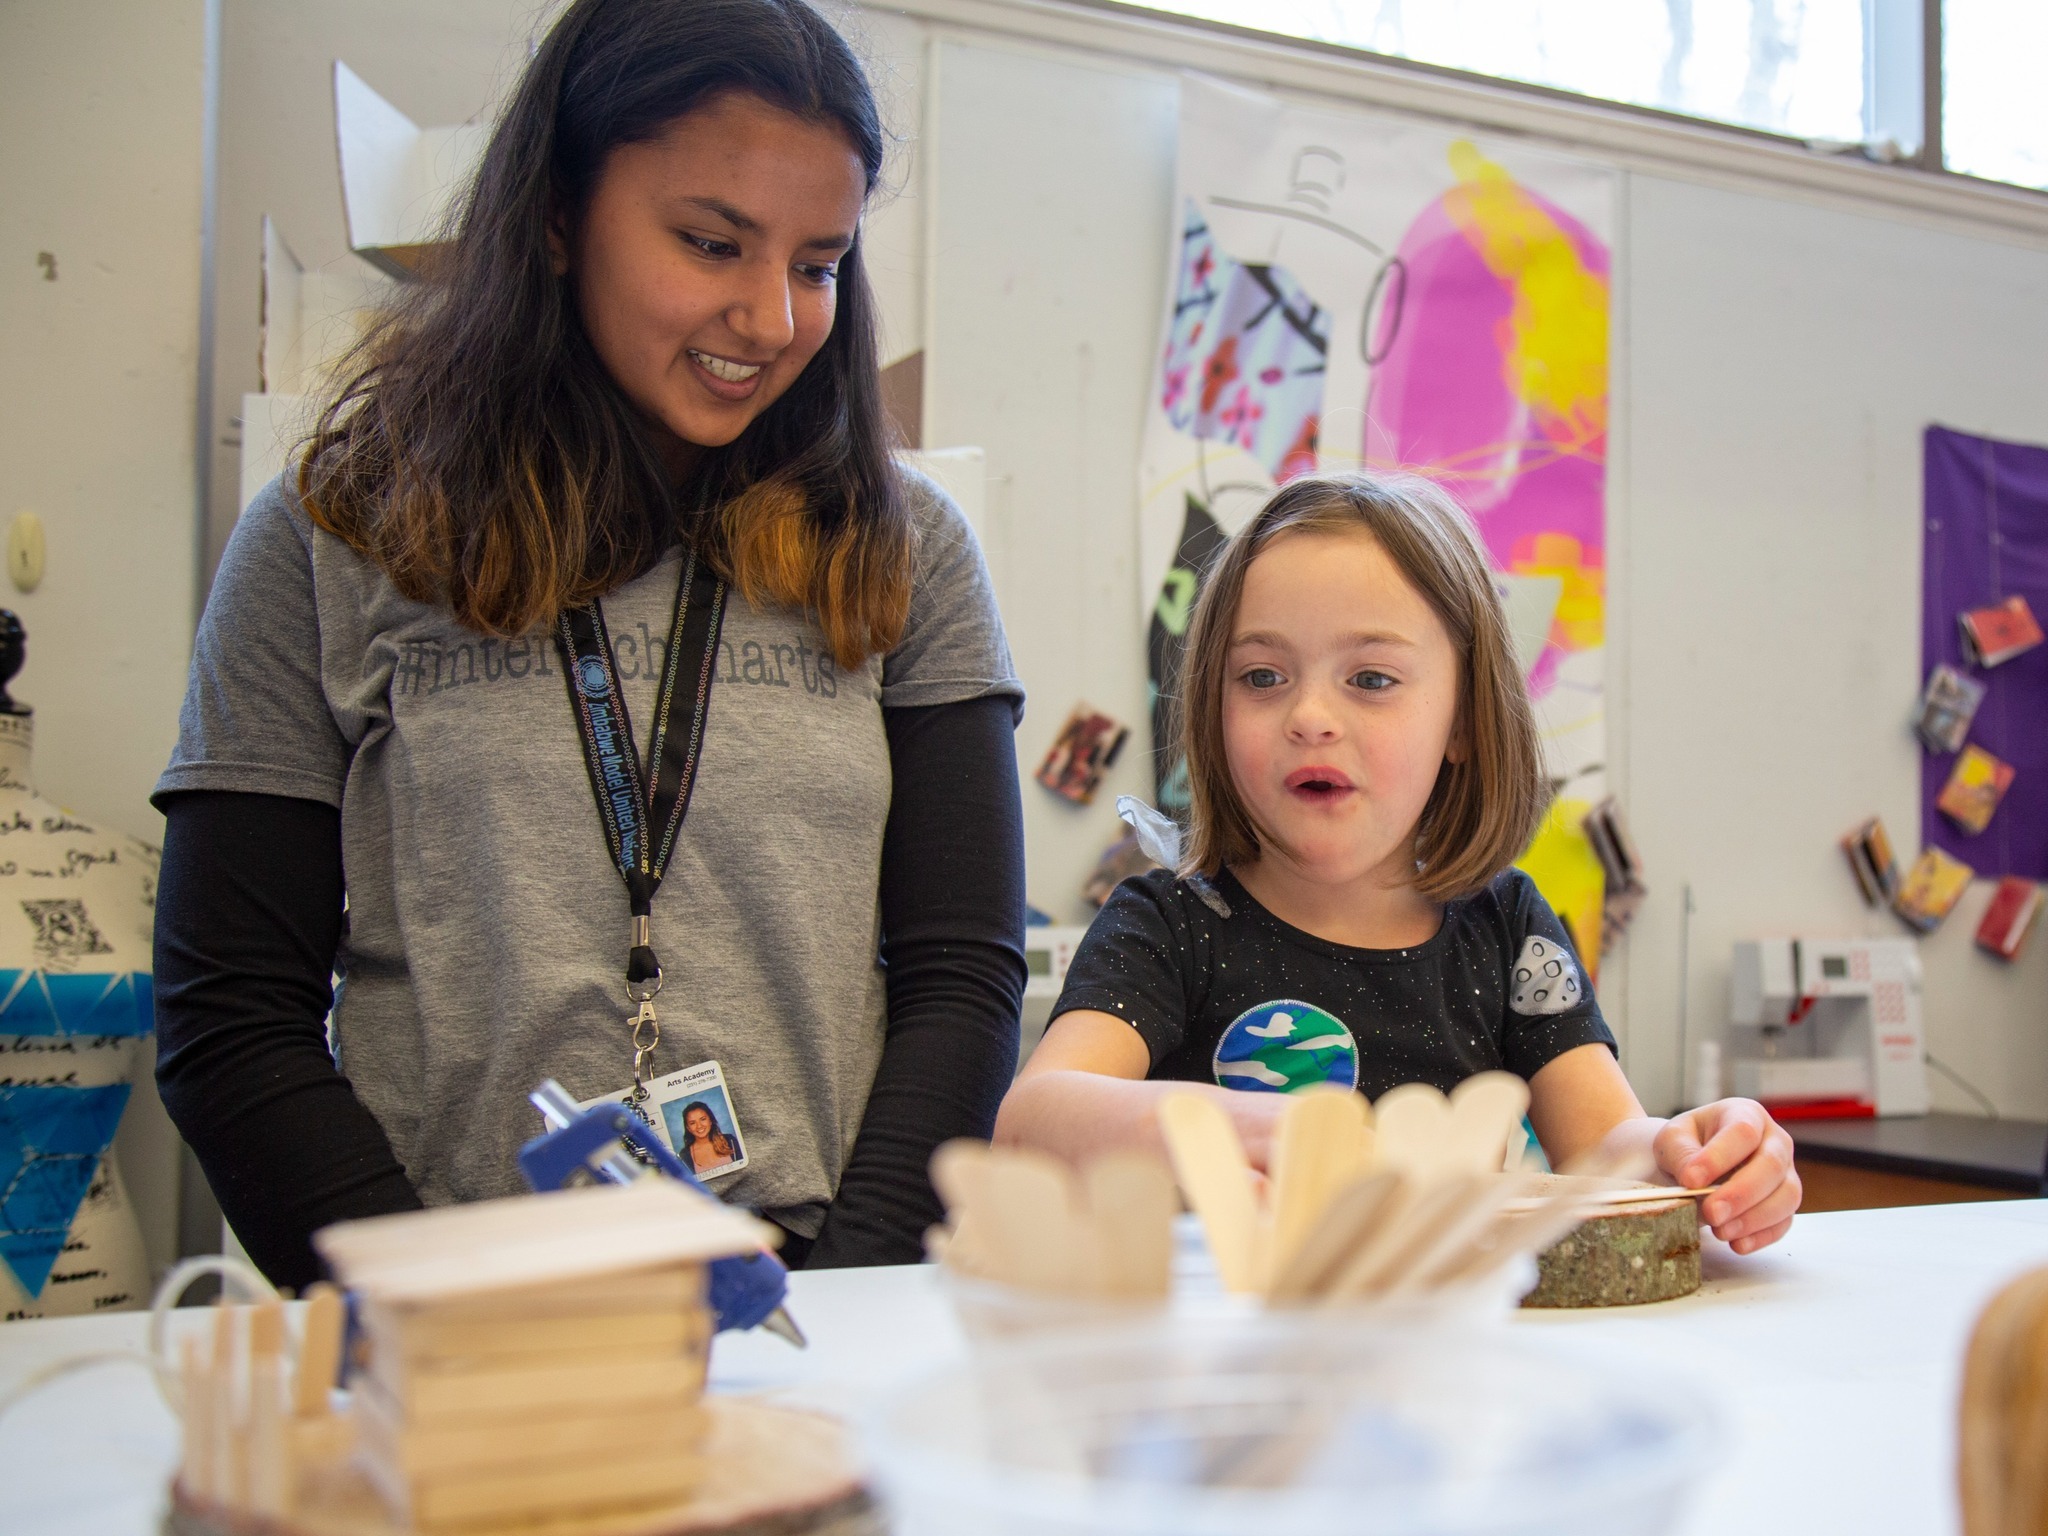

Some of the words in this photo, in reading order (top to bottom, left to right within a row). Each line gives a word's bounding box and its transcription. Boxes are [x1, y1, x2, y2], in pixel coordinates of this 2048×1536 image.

[399, 622, 838, 699] #interchnarts
[588, 702, 618, 756] Zimbabwe
[601, 754, 631, 791] Model
[612, 789, 638, 831] United
[621, 828, 639, 871] Nations
[667, 1079, 682, 1087] Arts
[683, 1068, 715, 1082] Academy
